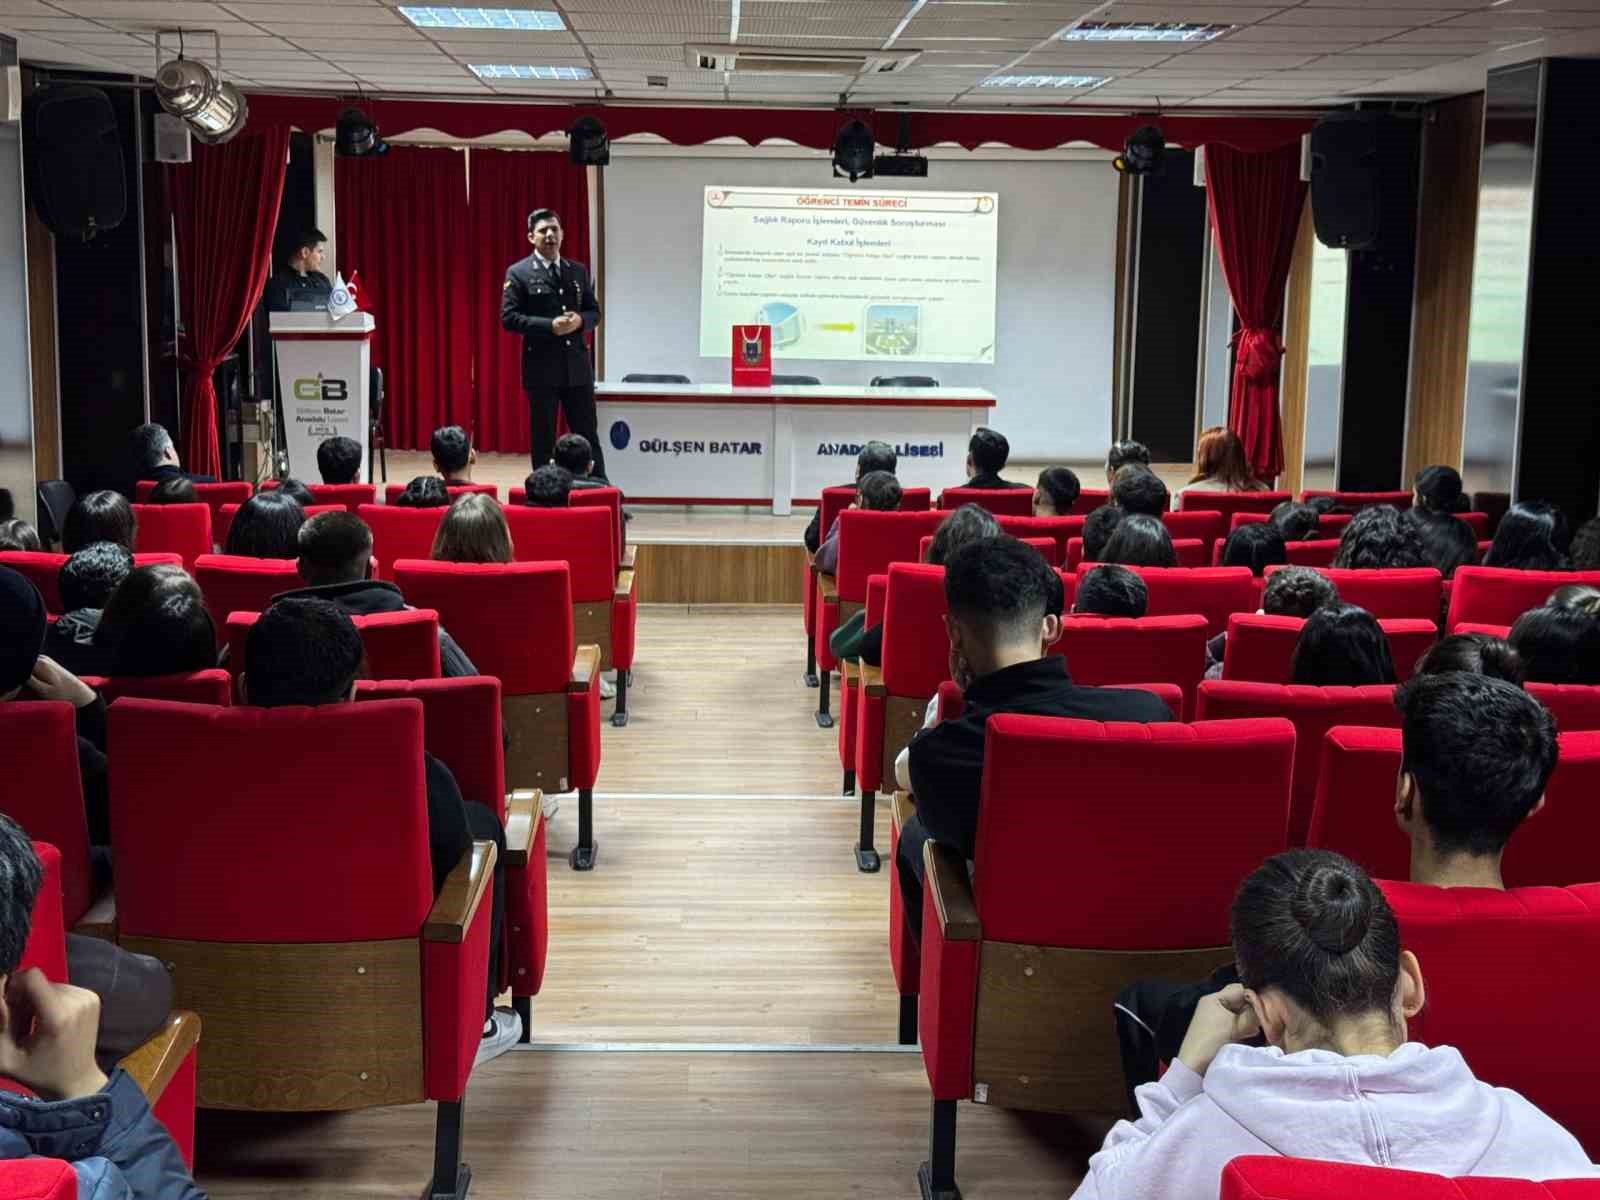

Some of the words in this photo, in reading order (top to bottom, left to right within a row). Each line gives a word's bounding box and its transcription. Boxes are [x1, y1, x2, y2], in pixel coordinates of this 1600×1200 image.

[797, 194, 839, 206] ÖĞRENCİ
[843, 197, 870, 208] TEMİN
[872, 196, 908, 209] SÜRECİ
[639, 438, 705, 457] GÜLŞEN
[708, 441, 763, 455] BATAR
[895, 441, 944, 458] LİSESİ
